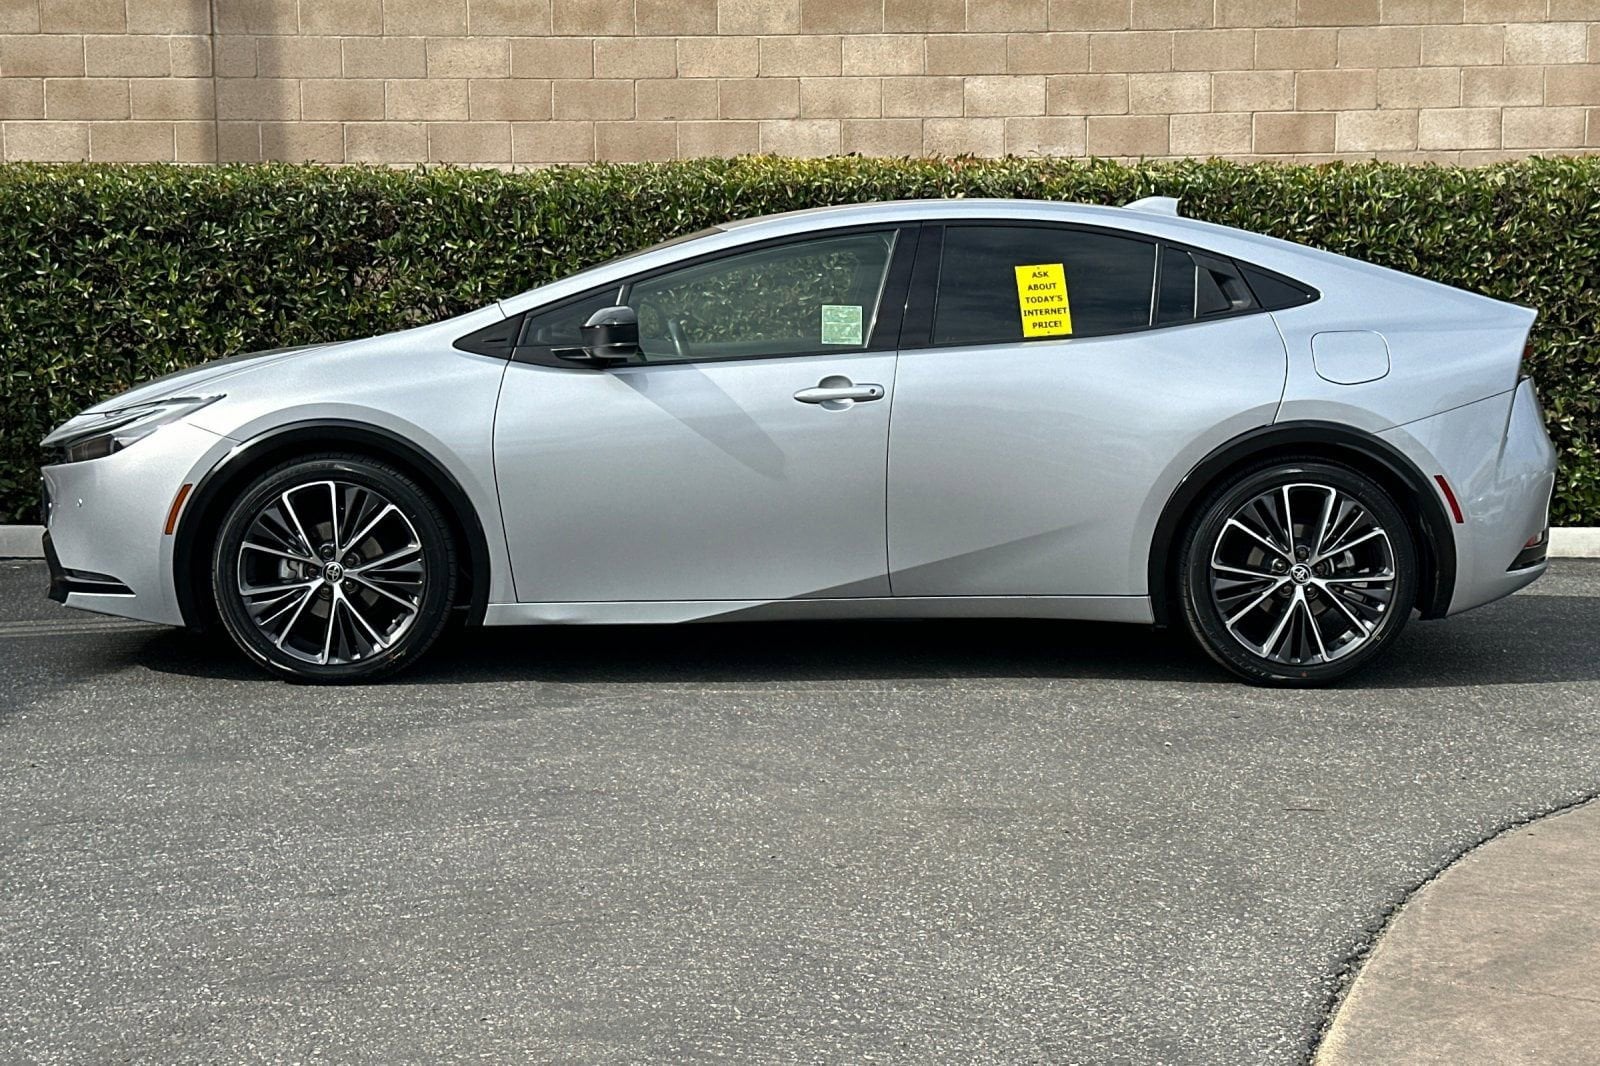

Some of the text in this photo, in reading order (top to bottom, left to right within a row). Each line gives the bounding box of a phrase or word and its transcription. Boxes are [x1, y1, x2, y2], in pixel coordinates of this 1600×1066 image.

[1028, 282, 1056, 291] ABOUT
[1025, 295, 1063, 304] TODAY'S
[1023, 307, 1067, 317] INTERNET
[1032, 320, 1062, 329] PRICE!
